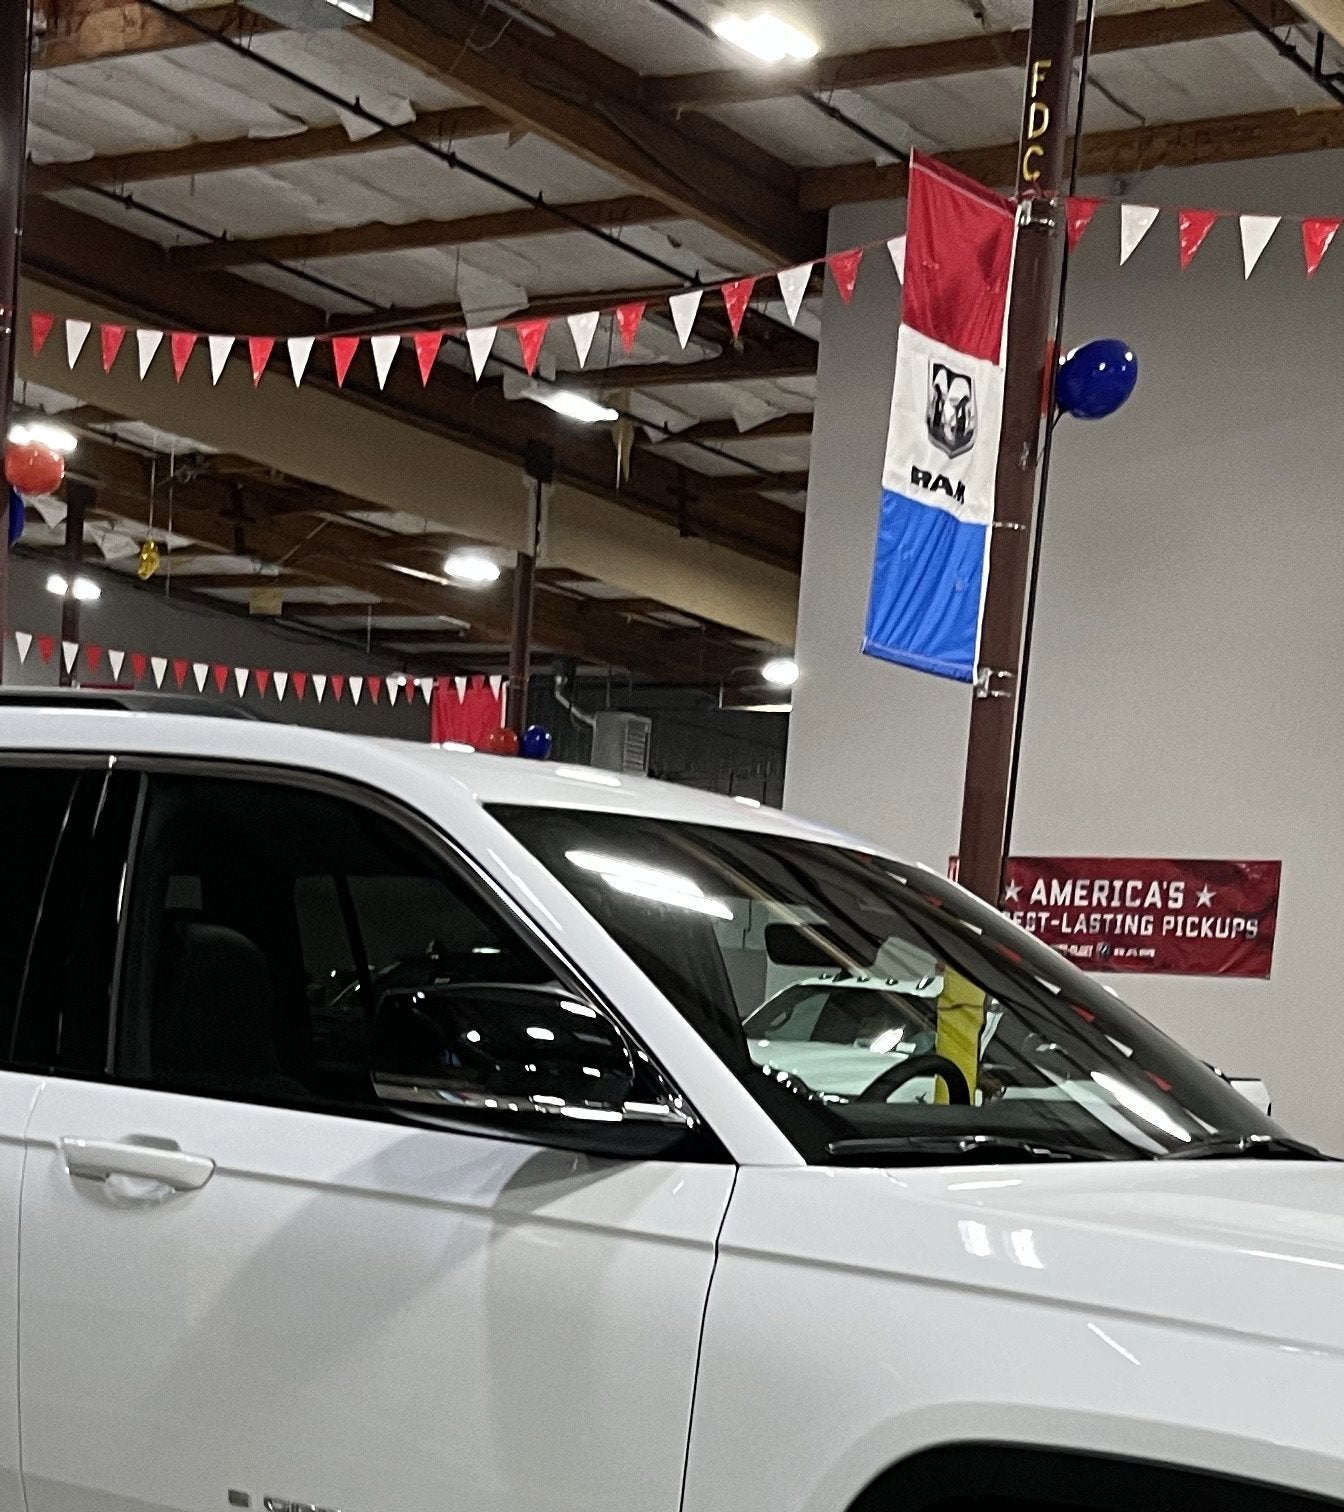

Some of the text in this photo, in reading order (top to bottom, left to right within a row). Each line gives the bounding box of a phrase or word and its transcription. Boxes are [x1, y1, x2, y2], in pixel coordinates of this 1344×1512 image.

[1023, 59, 1052, 182] FDC
[1029, 878, 1186, 909] AMERICA'S
[1161, 915, 1258, 939] PICKUPS
